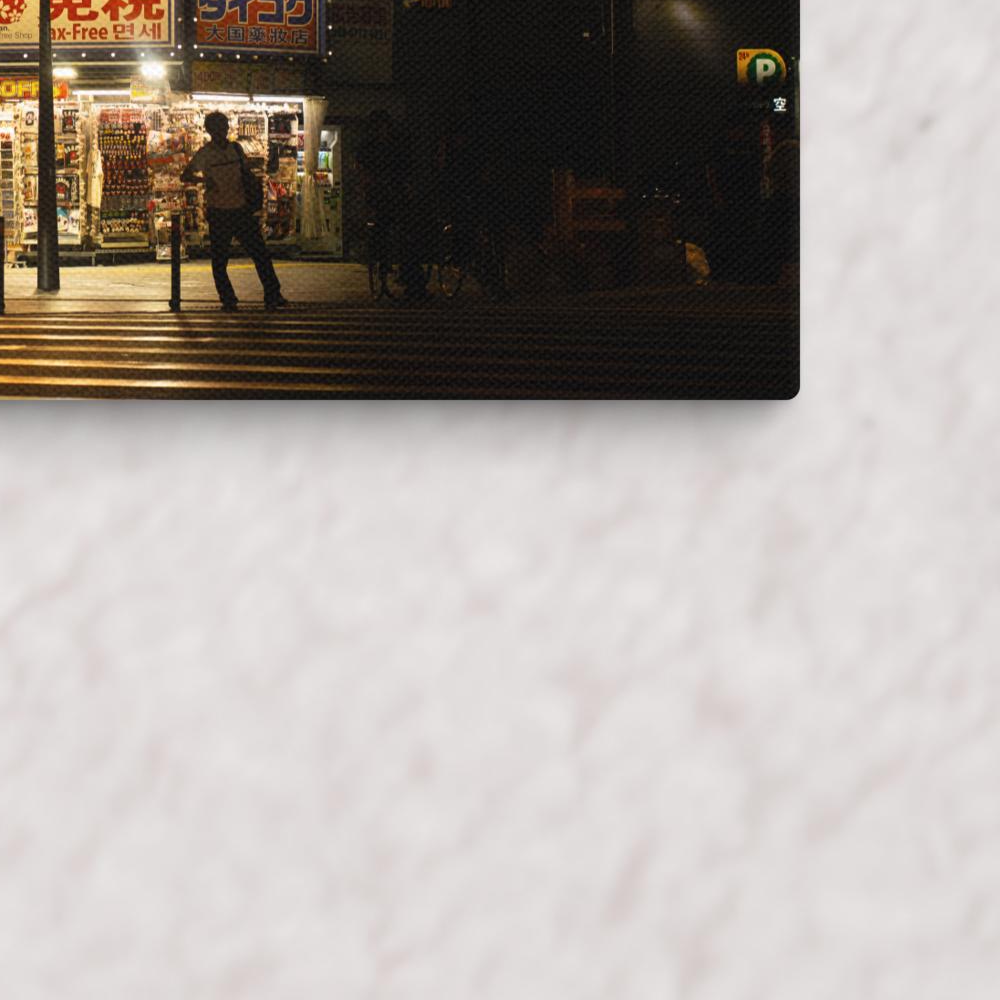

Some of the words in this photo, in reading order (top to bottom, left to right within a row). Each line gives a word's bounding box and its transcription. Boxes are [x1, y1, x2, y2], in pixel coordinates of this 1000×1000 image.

[40, 23, 109, 40] ax-Free
[756, 58, 776, 83] P
[773, 96, 787, 112] 空
